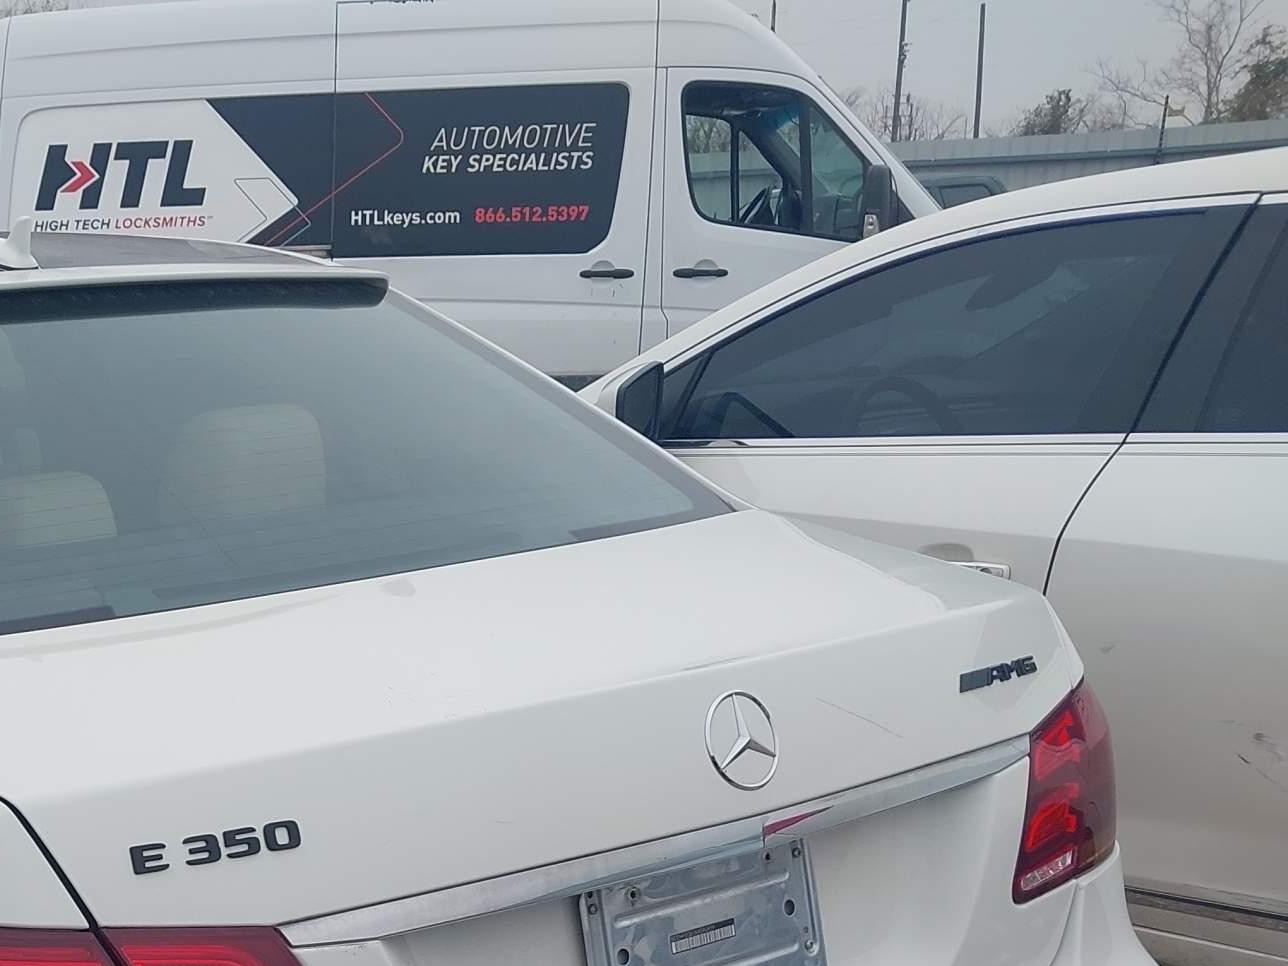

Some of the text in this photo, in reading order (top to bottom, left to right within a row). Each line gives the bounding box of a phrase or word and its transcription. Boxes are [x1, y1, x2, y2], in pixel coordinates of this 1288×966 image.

[430, 123, 597, 151] AUTOMOTIVE
[34, 139, 207, 211] HTL
[422, 152, 594, 174] KEY SPECIALISTS
[33, 215, 207, 233] HIGH TECH LOCKSMITHS
[350, 205, 590, 229] HTLkeys.com 866.512.5397
[986, 655, 1038, 685] AMG
[129, 820, 302, 875] E 350
